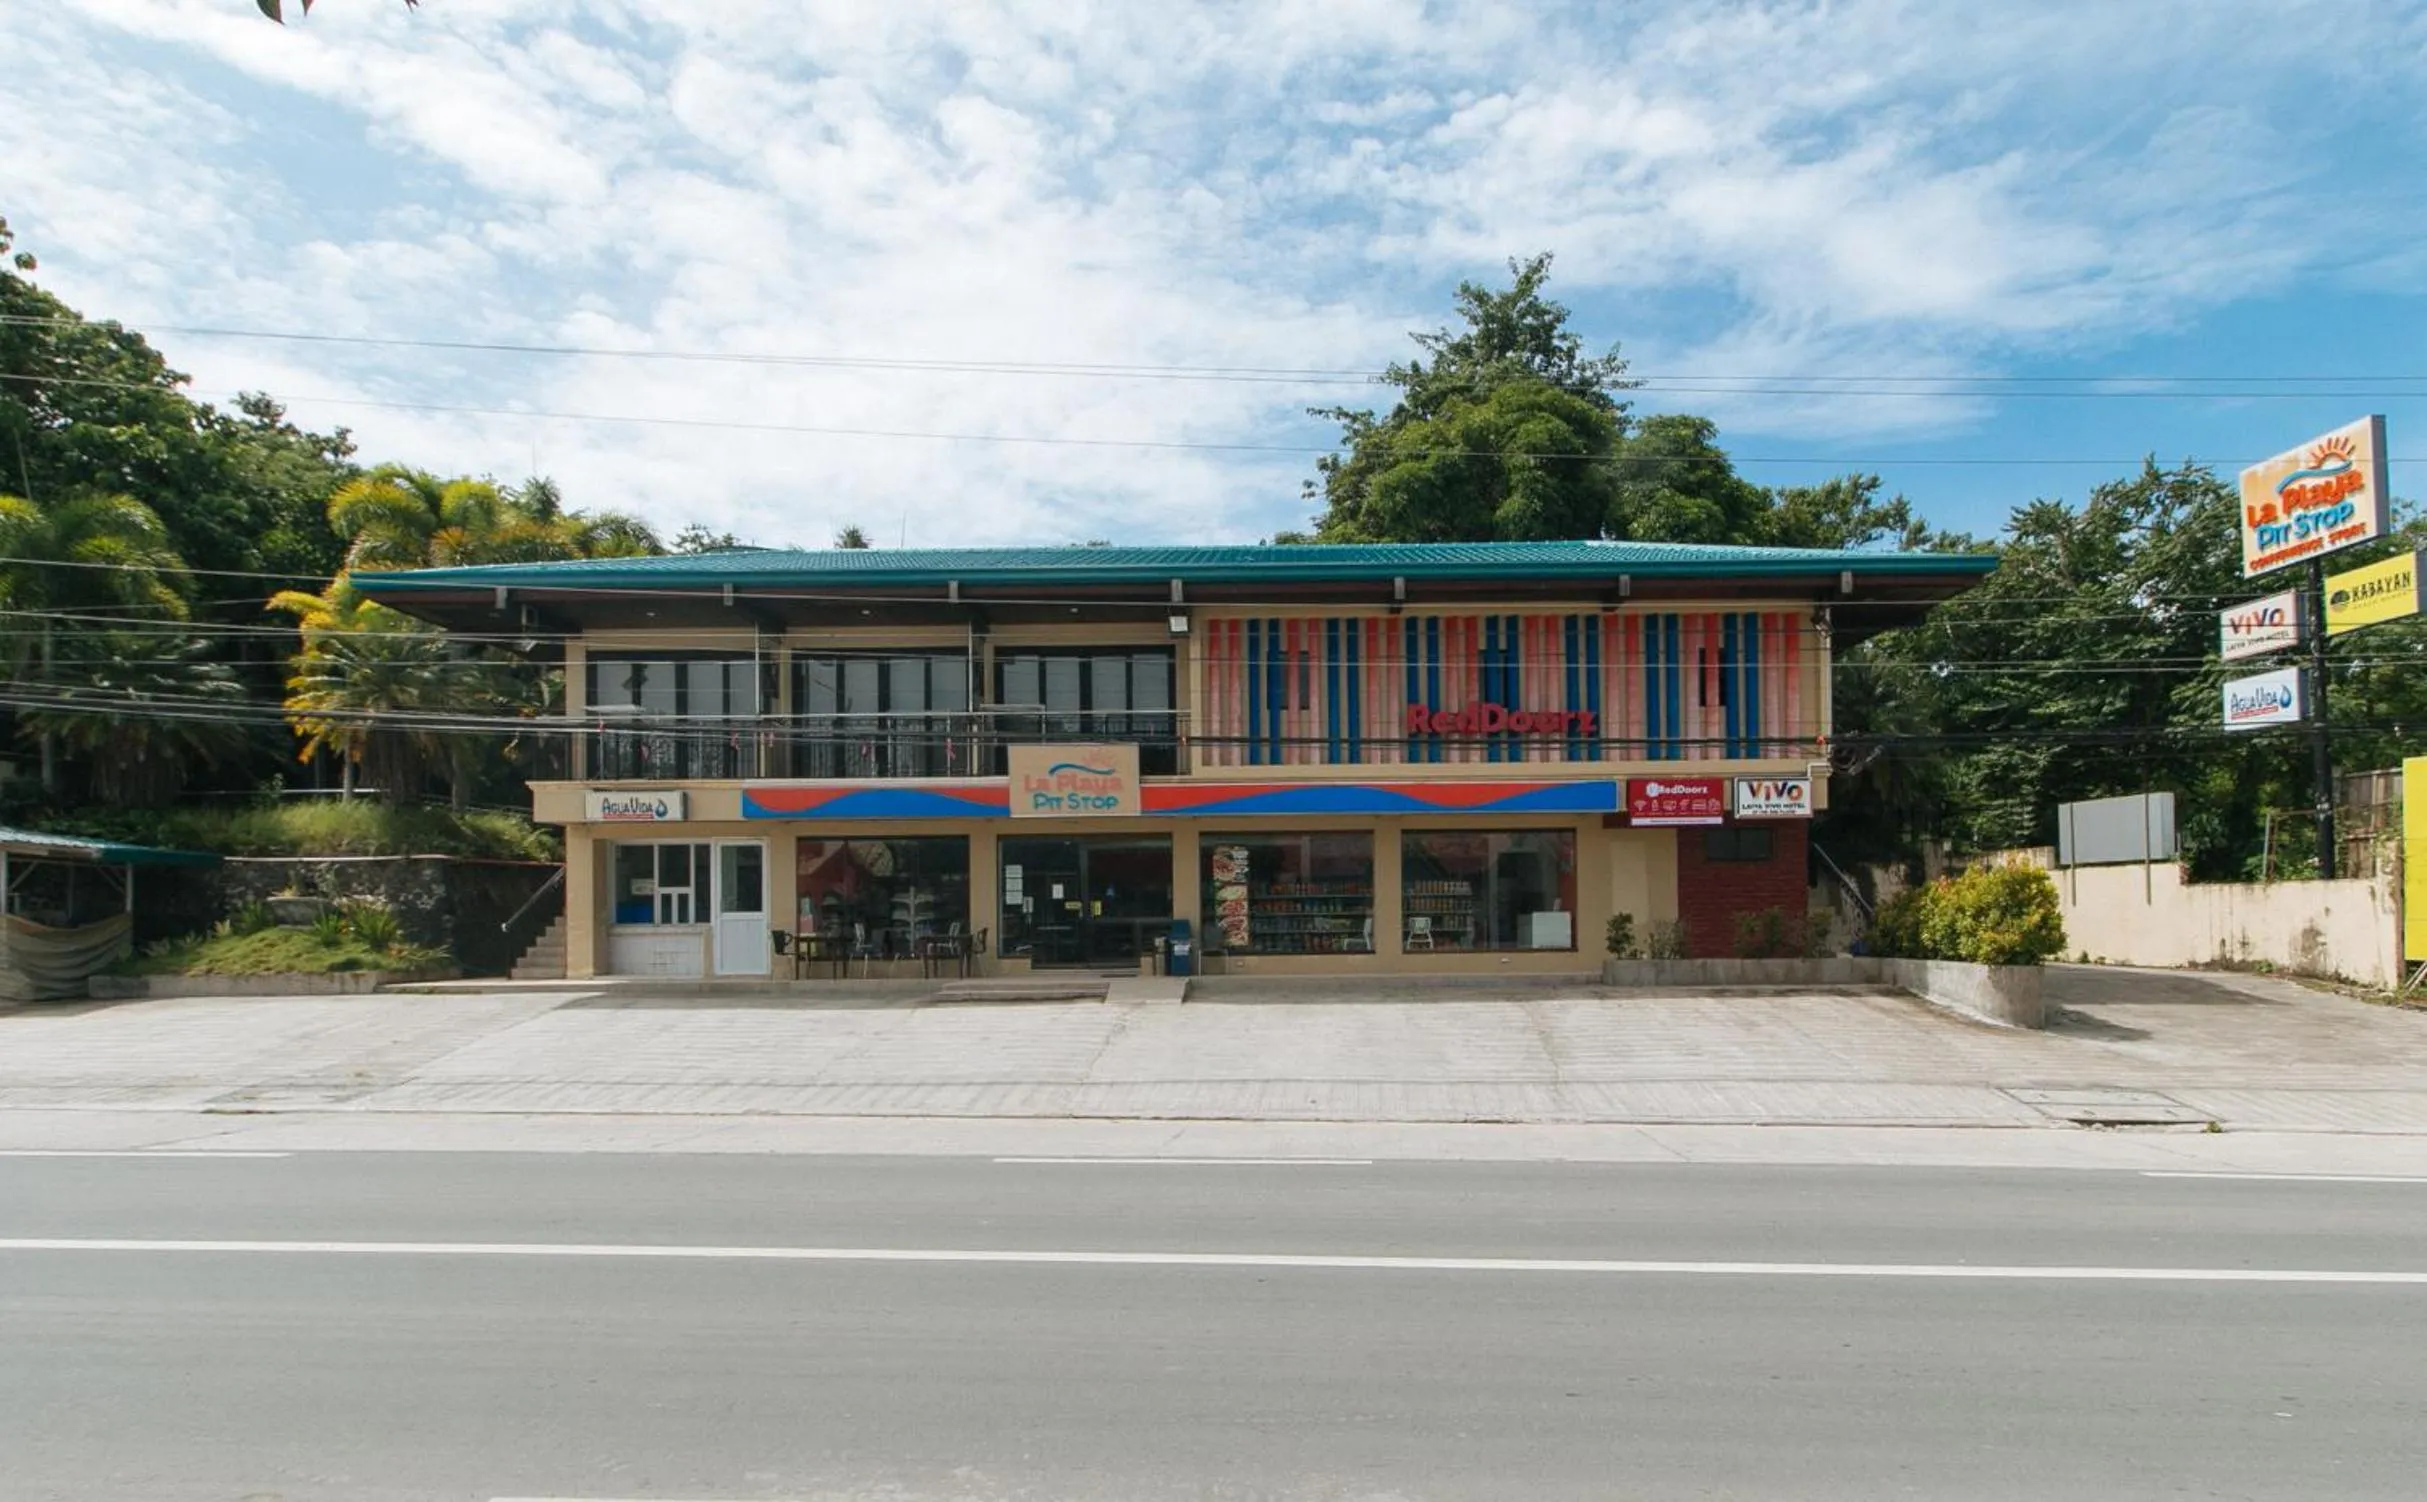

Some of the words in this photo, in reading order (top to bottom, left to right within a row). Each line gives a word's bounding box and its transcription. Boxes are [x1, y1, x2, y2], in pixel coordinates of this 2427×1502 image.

[2247, 503, 2278, 528] La
[2282, 470, 2365, 515] Playa
[2293, 500, 2354, 539] STOP
[2352, 571, 2411, 602] KABAYAN
[1407, 701, 1597, 734] RedDoorz
[1024, 774, 1051, 792] La
[1056, 771, 1123, 795] Playa
[1067, 792, 1119, 810] STOP
